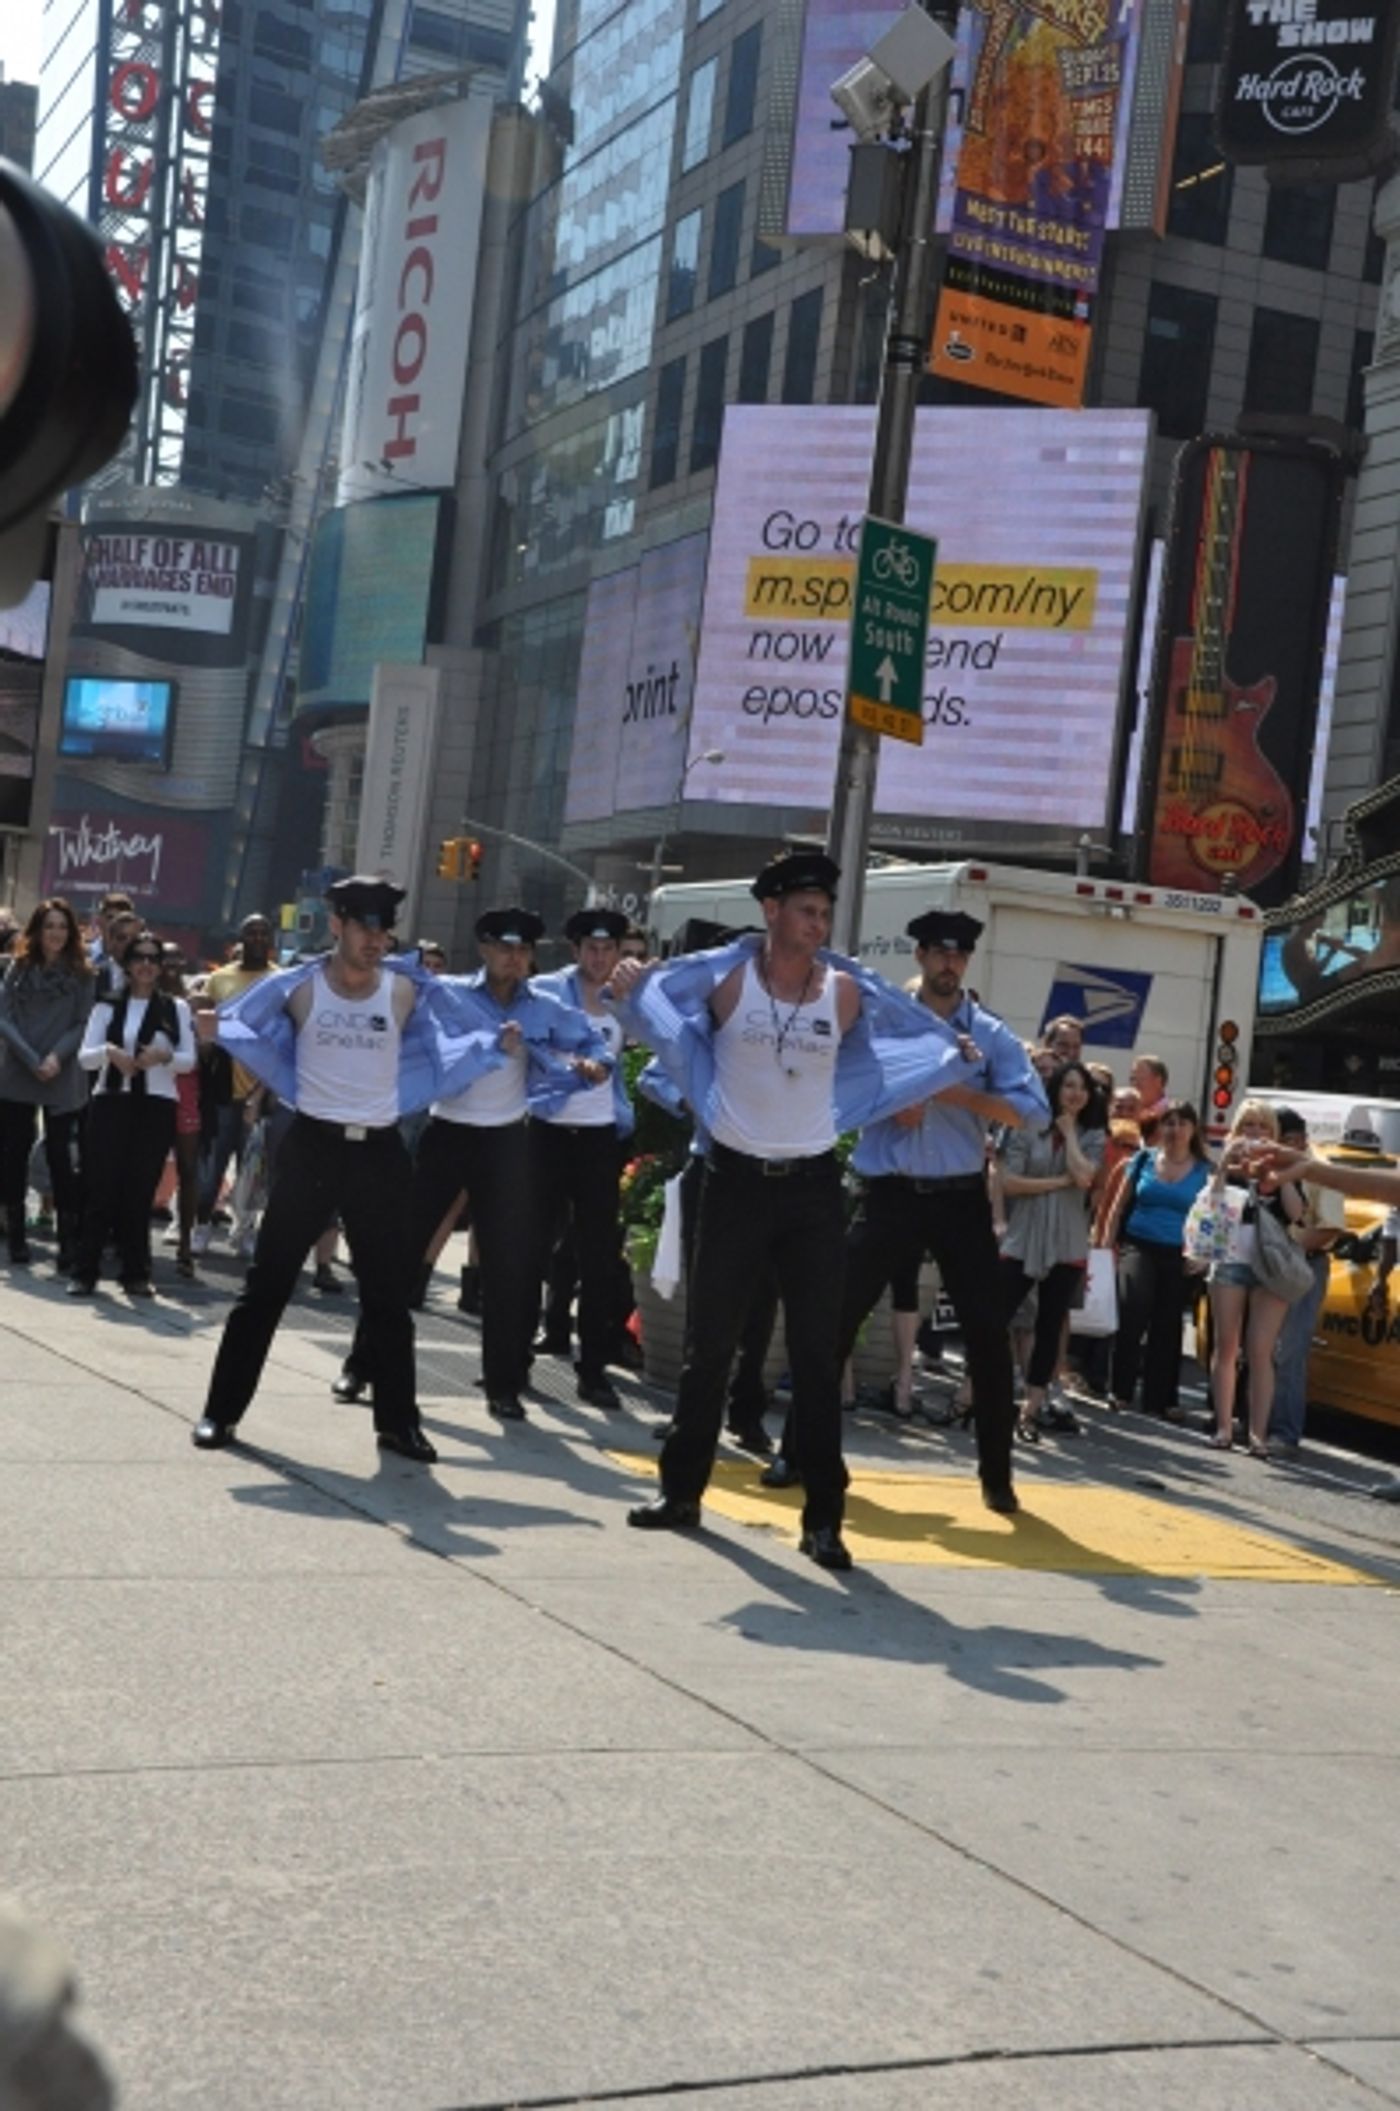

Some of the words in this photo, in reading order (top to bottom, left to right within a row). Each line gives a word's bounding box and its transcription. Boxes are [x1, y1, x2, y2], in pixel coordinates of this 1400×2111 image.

[1246, 0, 1317, 25] THE
[1277, 17, 1375, 47] SHOW
[1234, 68, 1302, 100] Hard
[1302, 66, 1366, 103] Rock
[384, 138, 446, 459] RICOH
[762, 511, 821, 550] Go
[153, 538, 185, 569] OF
[190, 541, 236, 574] ALL
[748, 630, 834, 662] now
[864, 621, 915, 656] South
[49, 813, 162, 883] Whitney
